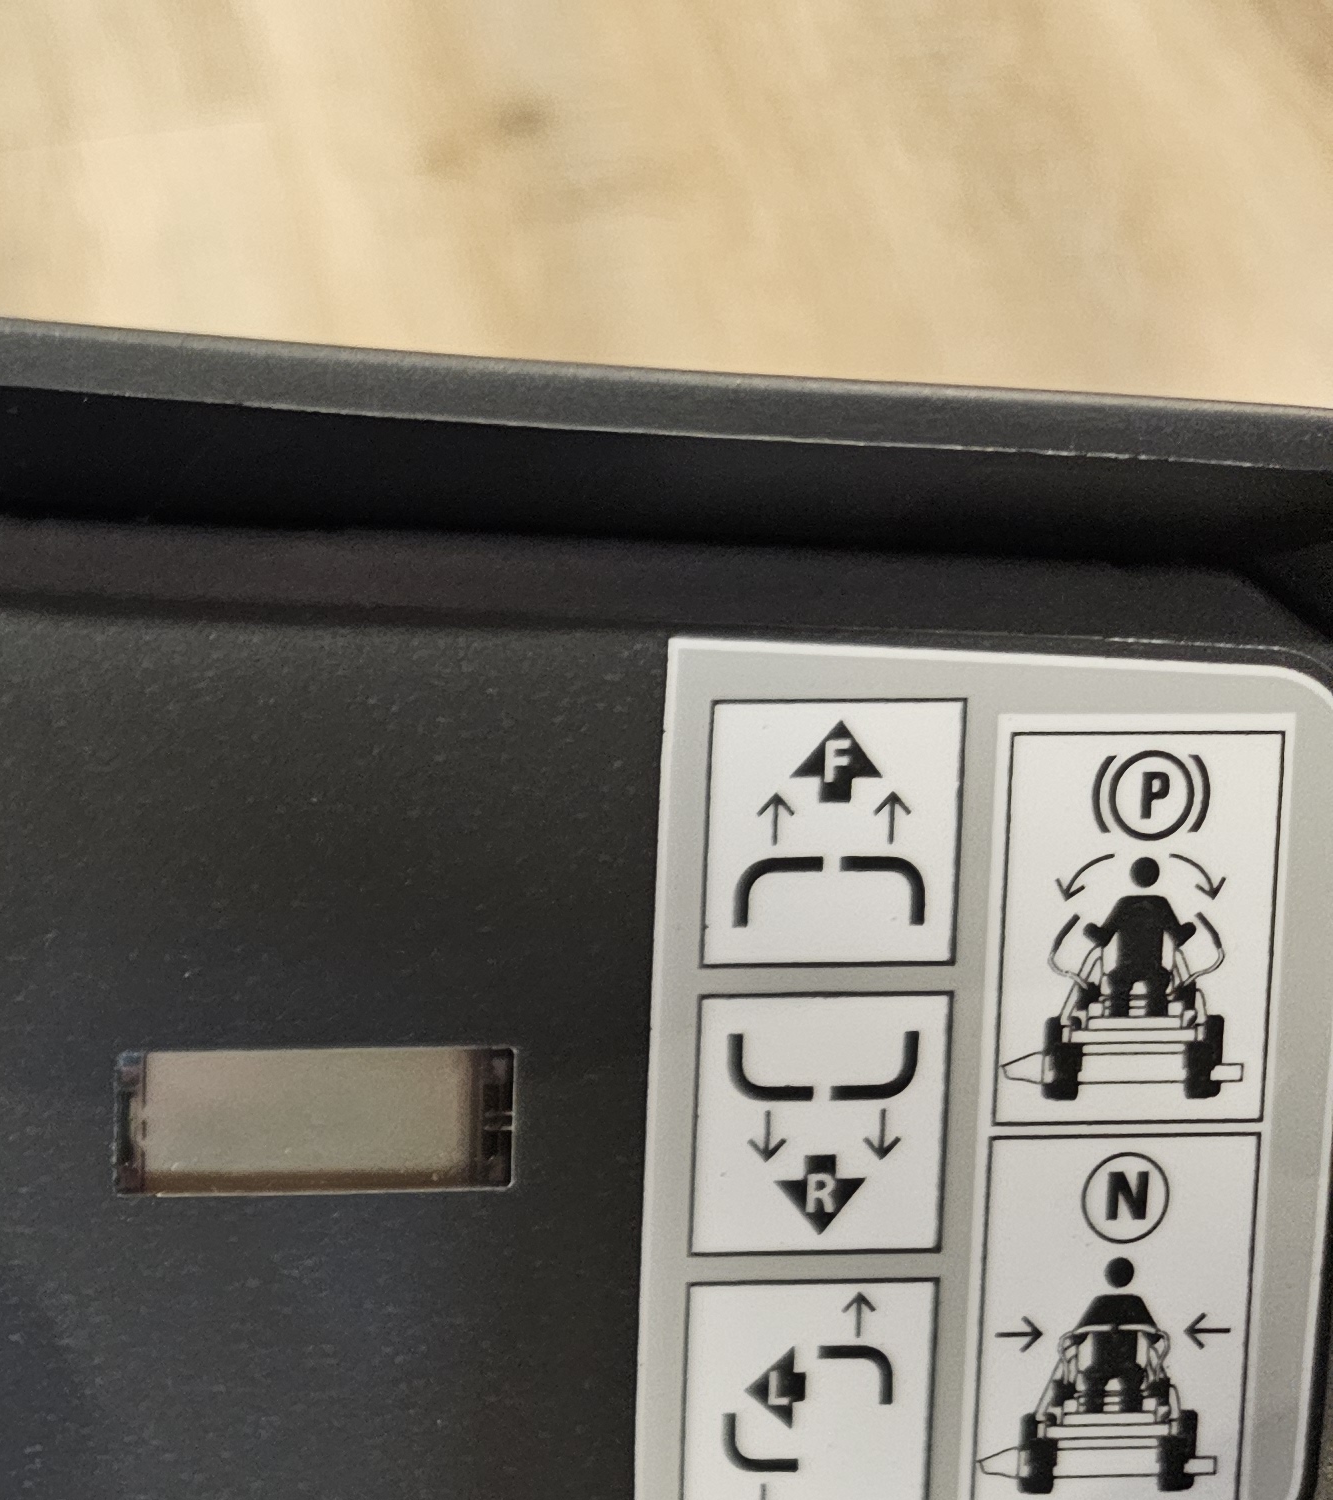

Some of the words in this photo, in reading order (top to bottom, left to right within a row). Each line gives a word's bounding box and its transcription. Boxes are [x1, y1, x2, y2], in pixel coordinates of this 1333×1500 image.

[824, 740, 851, 783] F
[1140, 771, 1170, 819] P
[806, 1175, 834, 1213] R
[1105, 1171, 1149, 1220] N
[768, 1372, 790, 1406] L
